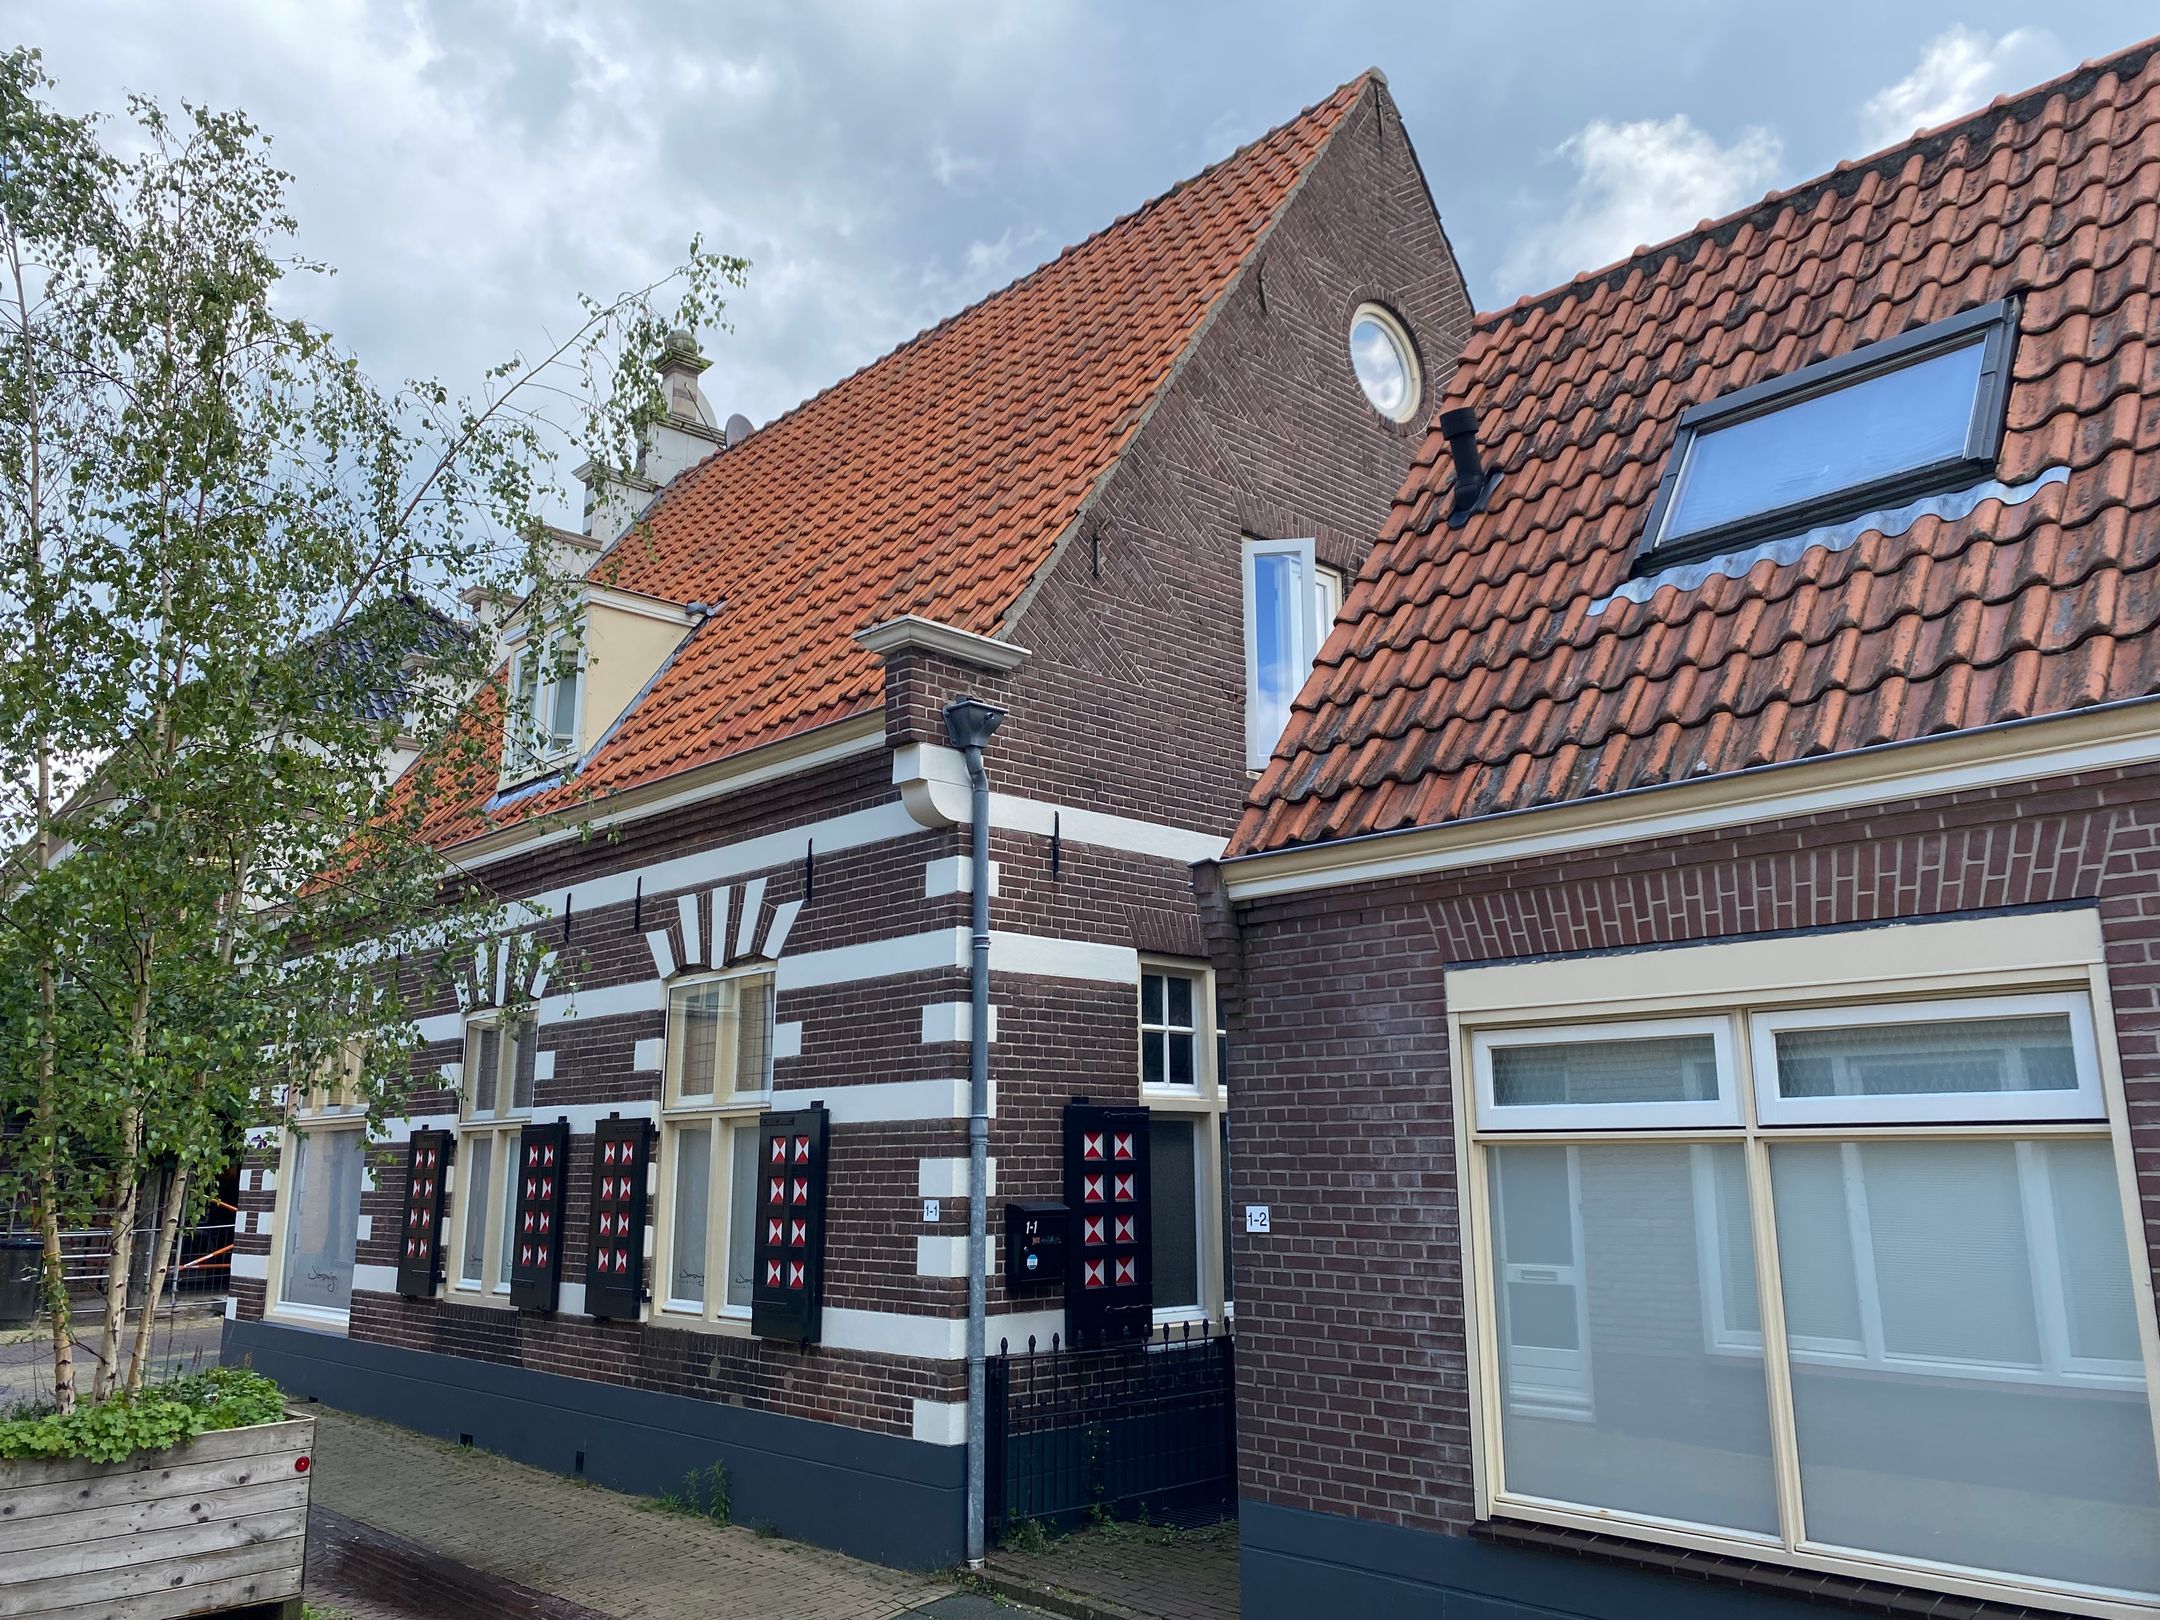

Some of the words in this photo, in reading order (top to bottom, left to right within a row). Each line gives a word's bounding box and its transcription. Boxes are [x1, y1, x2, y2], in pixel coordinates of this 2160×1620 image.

[926, 1205, 938, 1217] 1-1
[1248, 1212, 1268, 1227] 1-2
[1026, 1220, 1038, 1234] 1-1
